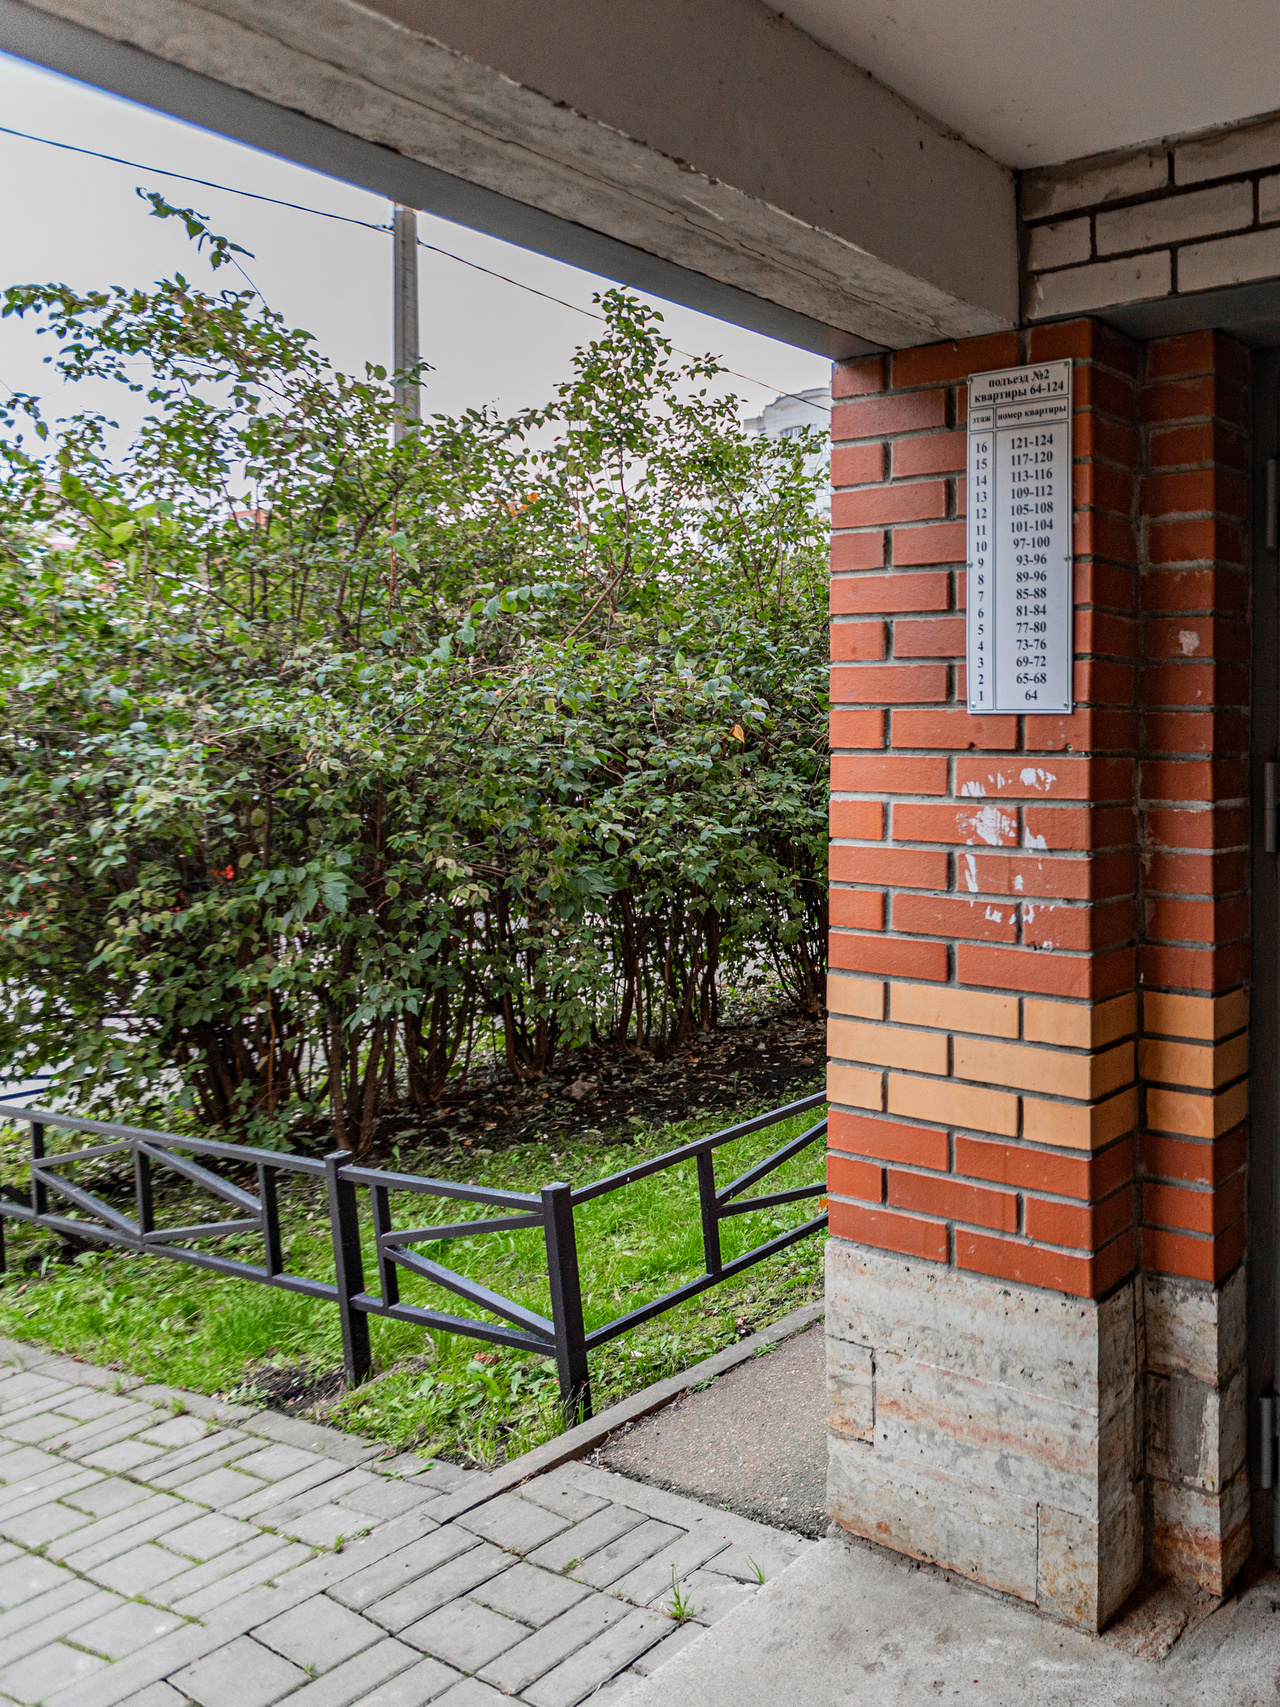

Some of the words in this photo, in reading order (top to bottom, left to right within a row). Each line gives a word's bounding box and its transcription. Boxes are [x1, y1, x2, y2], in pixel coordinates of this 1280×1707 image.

[988, 373, 1029, 388] подъезд
[1031, 368, 1050, 381] №2
[974, 388, 1027, 403] квартиры
[1030, 380, 1064, 395] 64-124
[972, 415, 991, 424] этаж
[997, 411, 1022, 420] номер
[1025, 405, 1066, 417] квартиры
[976, 441, 988, 454] 16
[1011, 433, 1053, 449] 121-124
[976, 458, 988, 470] 15
[1011, 450, 1053, 466] 117-120
[976, 475, 987, 486] 14
[1011, 467, 1053, 483] 113-116
[976, 491, 987, 503] 13
[1011, 484, 1053, 500] 109-112
[976, 508, 987, 519] 12
[1011, 501, 1053, 516] 105-108
[976, 524, 986, 536] 11
[1011, 518, 1053, 533] 101-104
[976, 541, 987, 552] 10
[1013, 536, 1050, 549] 97-100
[978, 557, 984, 569] 9
[1016, 553, 1047, 566] 93-96
[978, 574, 984, 585] 8
[1016, 570, 1047, 583] 89-96
[978, 591, 984, 602] 7
[1016, 587, 1047, 600] 85-88
[978, 607, 984, 618] 6
[1016, 604, 1047, 617] 81-84
[978, 624, 984, 635] 5
[1016, 621, 1047, 633] 77-80
[978, 640, 984, 651] 4
[1016, 638, 1047, 651] 73-76
[978, 657, 984, 668] 3
[1016, 655, 1046, 667] 69-72
[978, 674, 984, 685] 2
[1016, 672, 1047, 684] 65-68
[979, 690, 984, 701] 1
[1025, 689, 1038, 701] 64
